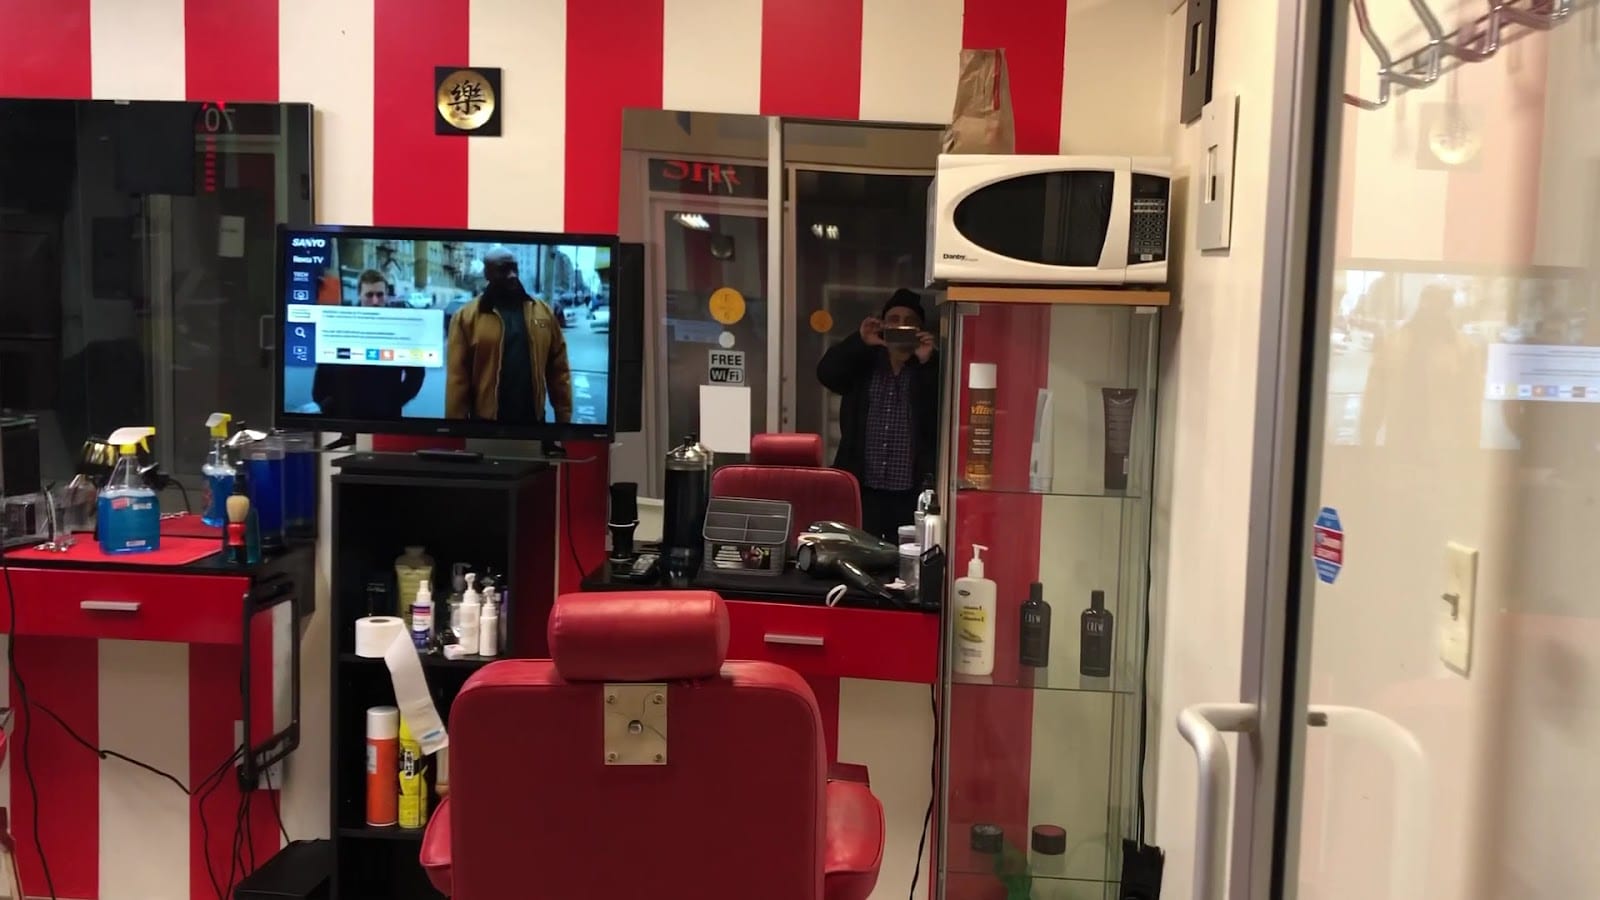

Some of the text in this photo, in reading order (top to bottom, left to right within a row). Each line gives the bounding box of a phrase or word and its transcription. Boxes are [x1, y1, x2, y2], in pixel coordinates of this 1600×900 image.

[447, 79, 487, 116] 樂
[292, 238, 326, 248] SANYO
[312, 256, 324, 264] TV
[942, 253, 966, 262] Danby
[711, 354, 742, 366] FREE
[1086, 621, 1104, 632] CREW
